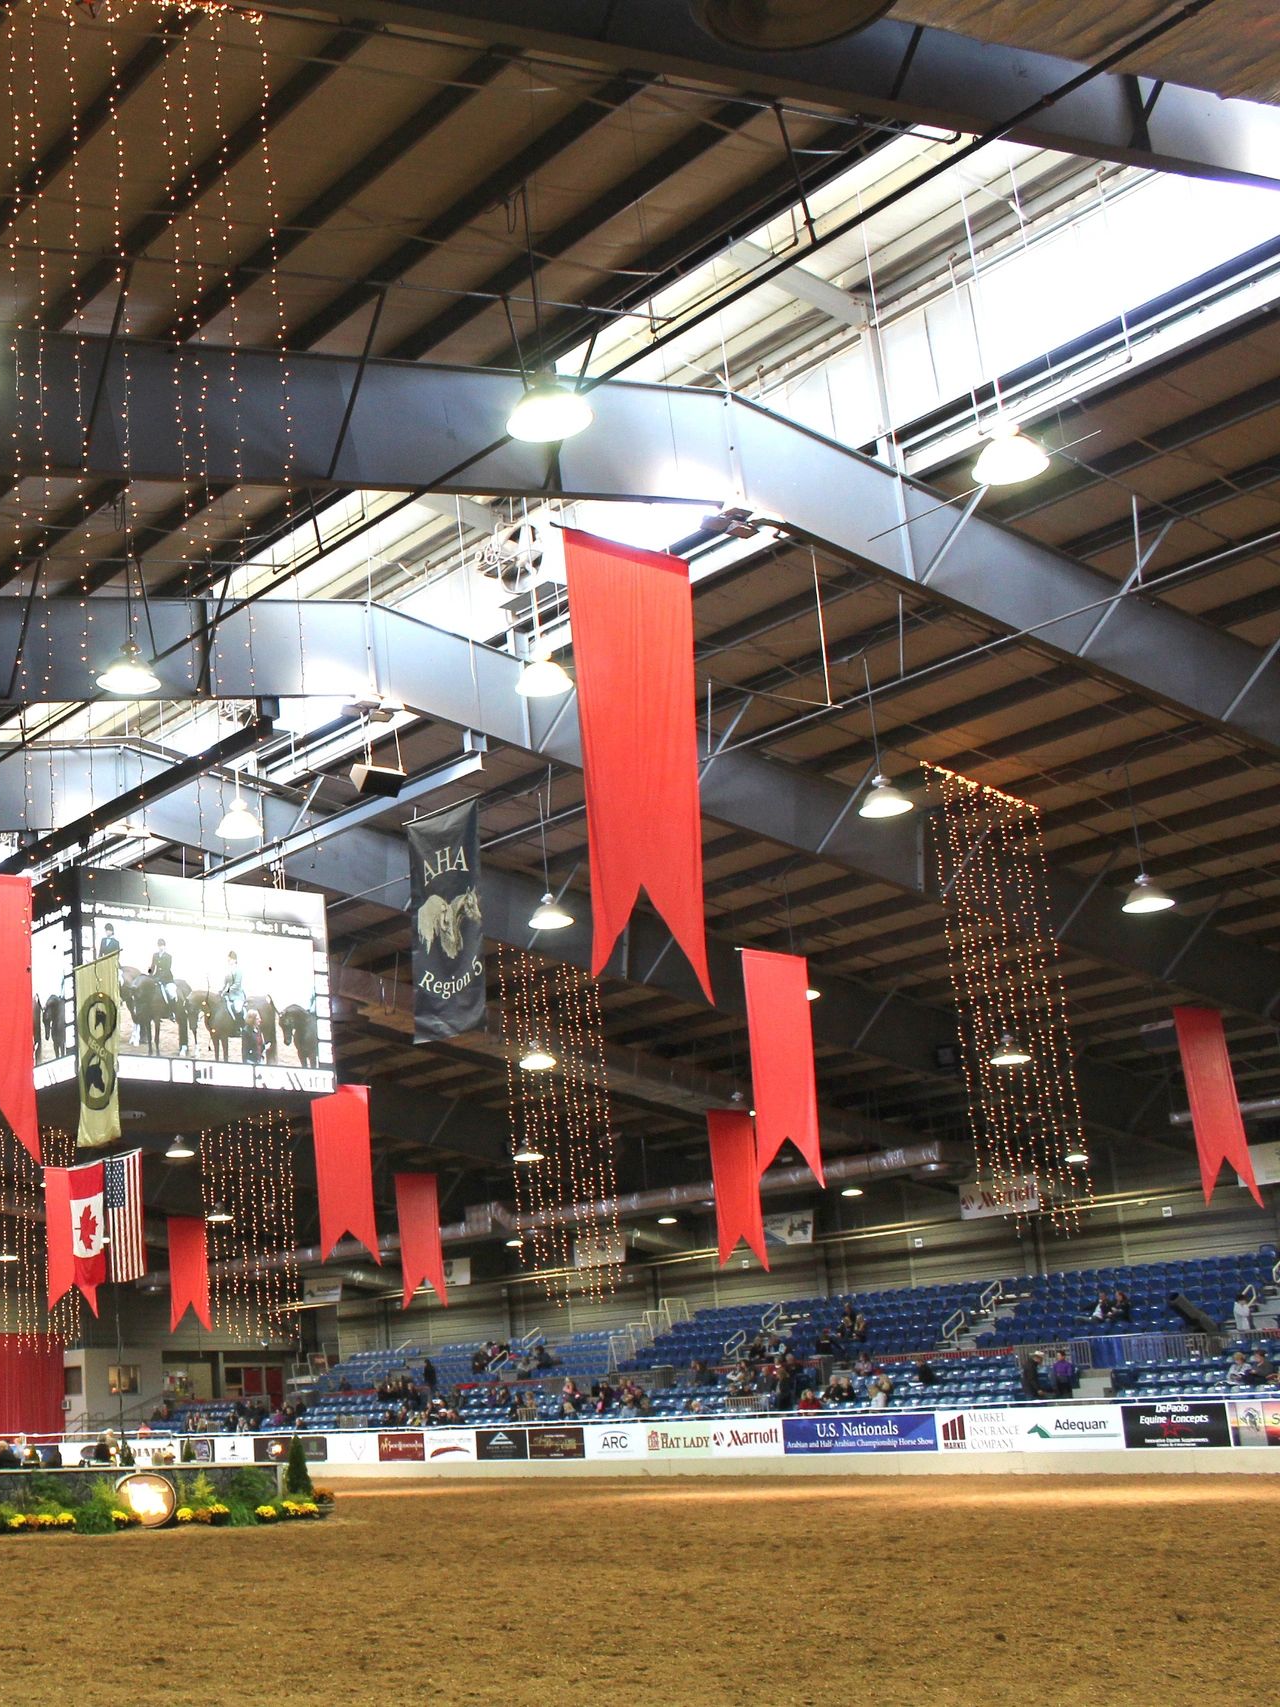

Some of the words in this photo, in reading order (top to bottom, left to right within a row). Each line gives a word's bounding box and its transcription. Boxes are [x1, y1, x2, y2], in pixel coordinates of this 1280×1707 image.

[424, 846, 469, 886] AHA
[419, 970, 471, 999] Region
[472, 956, 483, 976] 5
[1155, 1404, 1189, 1413] DePaolo
[968, 1413, 1006, 1423] MARKEL
[1140, 1415, 1167, 1425] Equine
[1171, 1414, 1209, 1424] Concepts
[815, 1423, 839, 1438] U.S.
[842, 1420, 899, 1436] Nationals
[970, 1424, 1020, 1437] INSURANCE
[1054, 1419, 1107, 1432] Adequan
[602, 1435, 628, 1449] ARC
[661, 1437, 681, 1449] HAT
[683, 1436, 709, 1448] LADY
[727, 1429, 779, 1448] Marriott
[787, 1440, 809, 1448] Arabian
[809, 1440, 819, 1448] and
[856, 1438, 898, 1448] Championship
[898, 1438, 916, 1446] Horse
[917, 1436, 934, 1446] Show
[944, 1440, 967, 1449] MARKEL
[971, 1438, 1015, 1449] COMPANY
